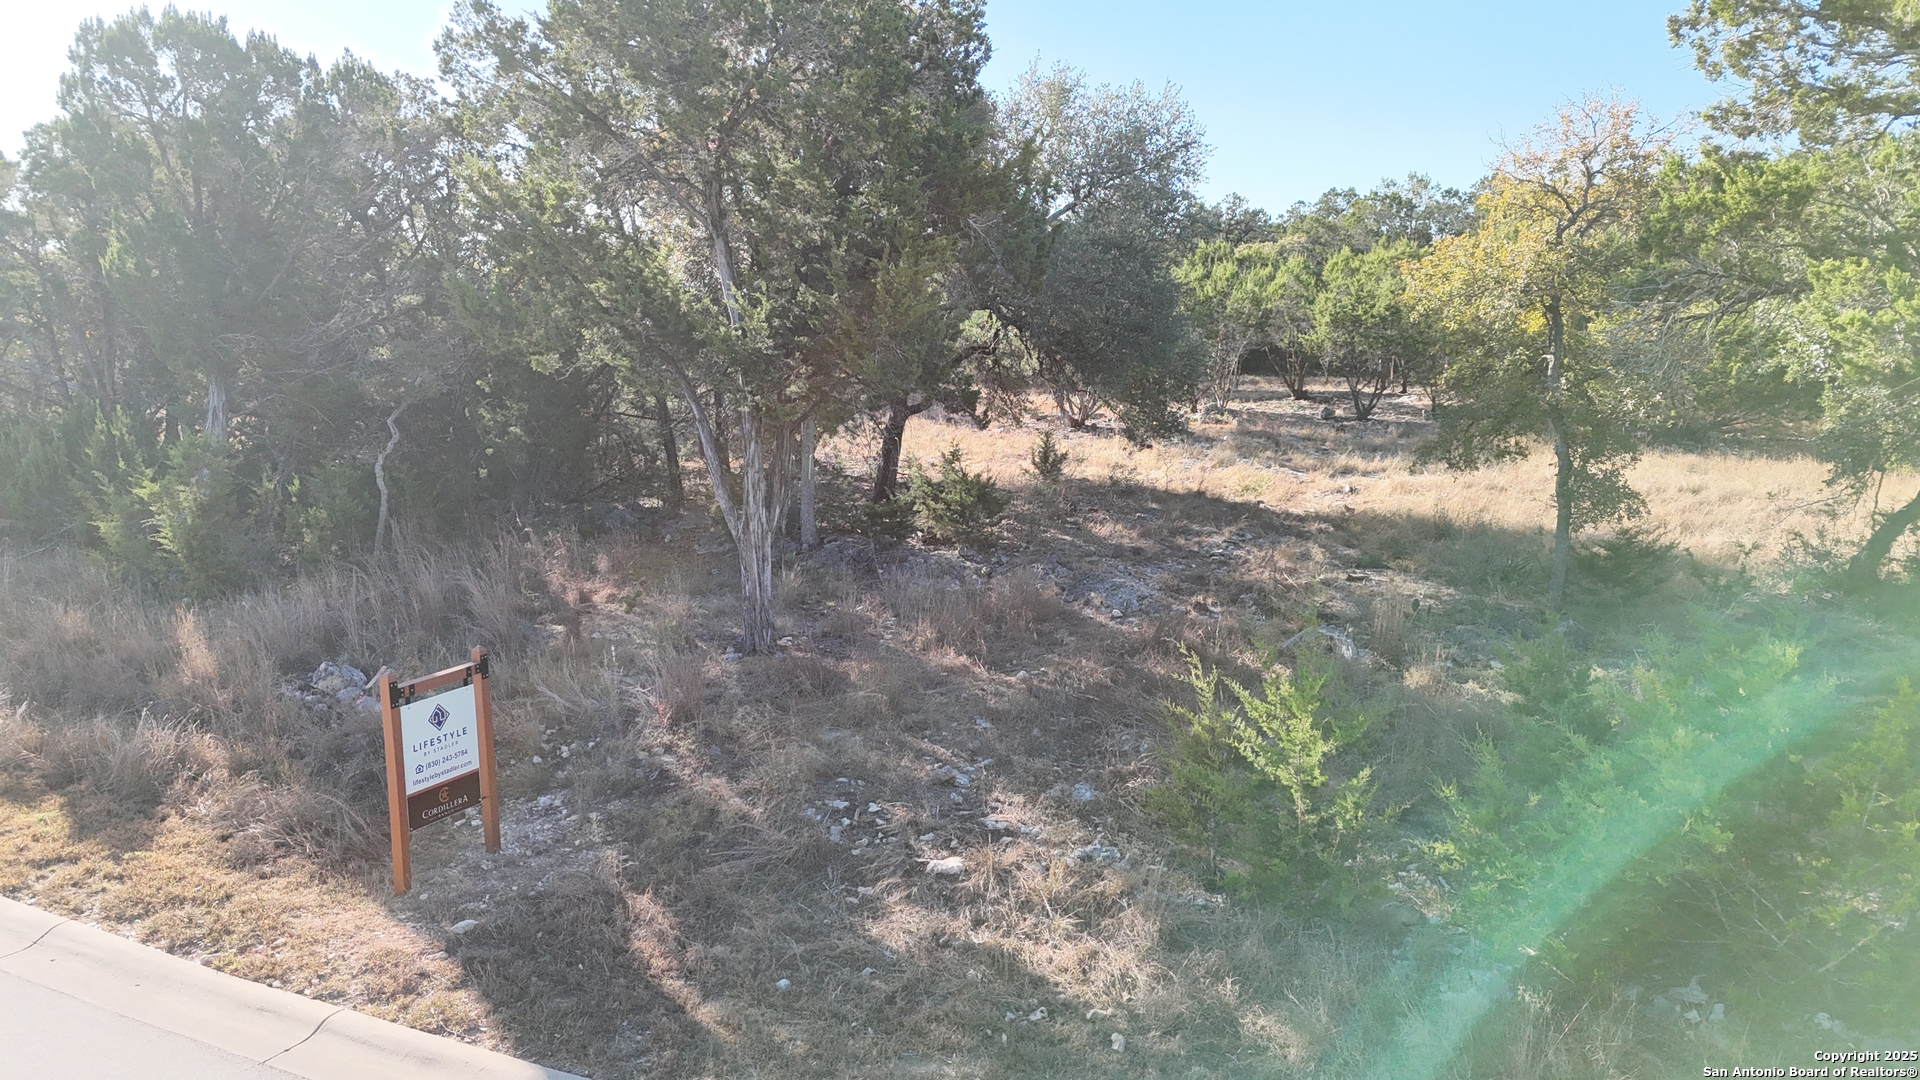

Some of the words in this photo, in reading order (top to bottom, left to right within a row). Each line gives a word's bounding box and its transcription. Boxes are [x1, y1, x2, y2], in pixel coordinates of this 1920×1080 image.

[412, 726, 468, 753] LIFESTYLE
[433, 740, 459, 753] STADLER
[412, 760, 472, 786] lifestylebystadler.com
[425, 759, 440, 770] (830)
[422, 794, 469, 819] CORDILLERA
